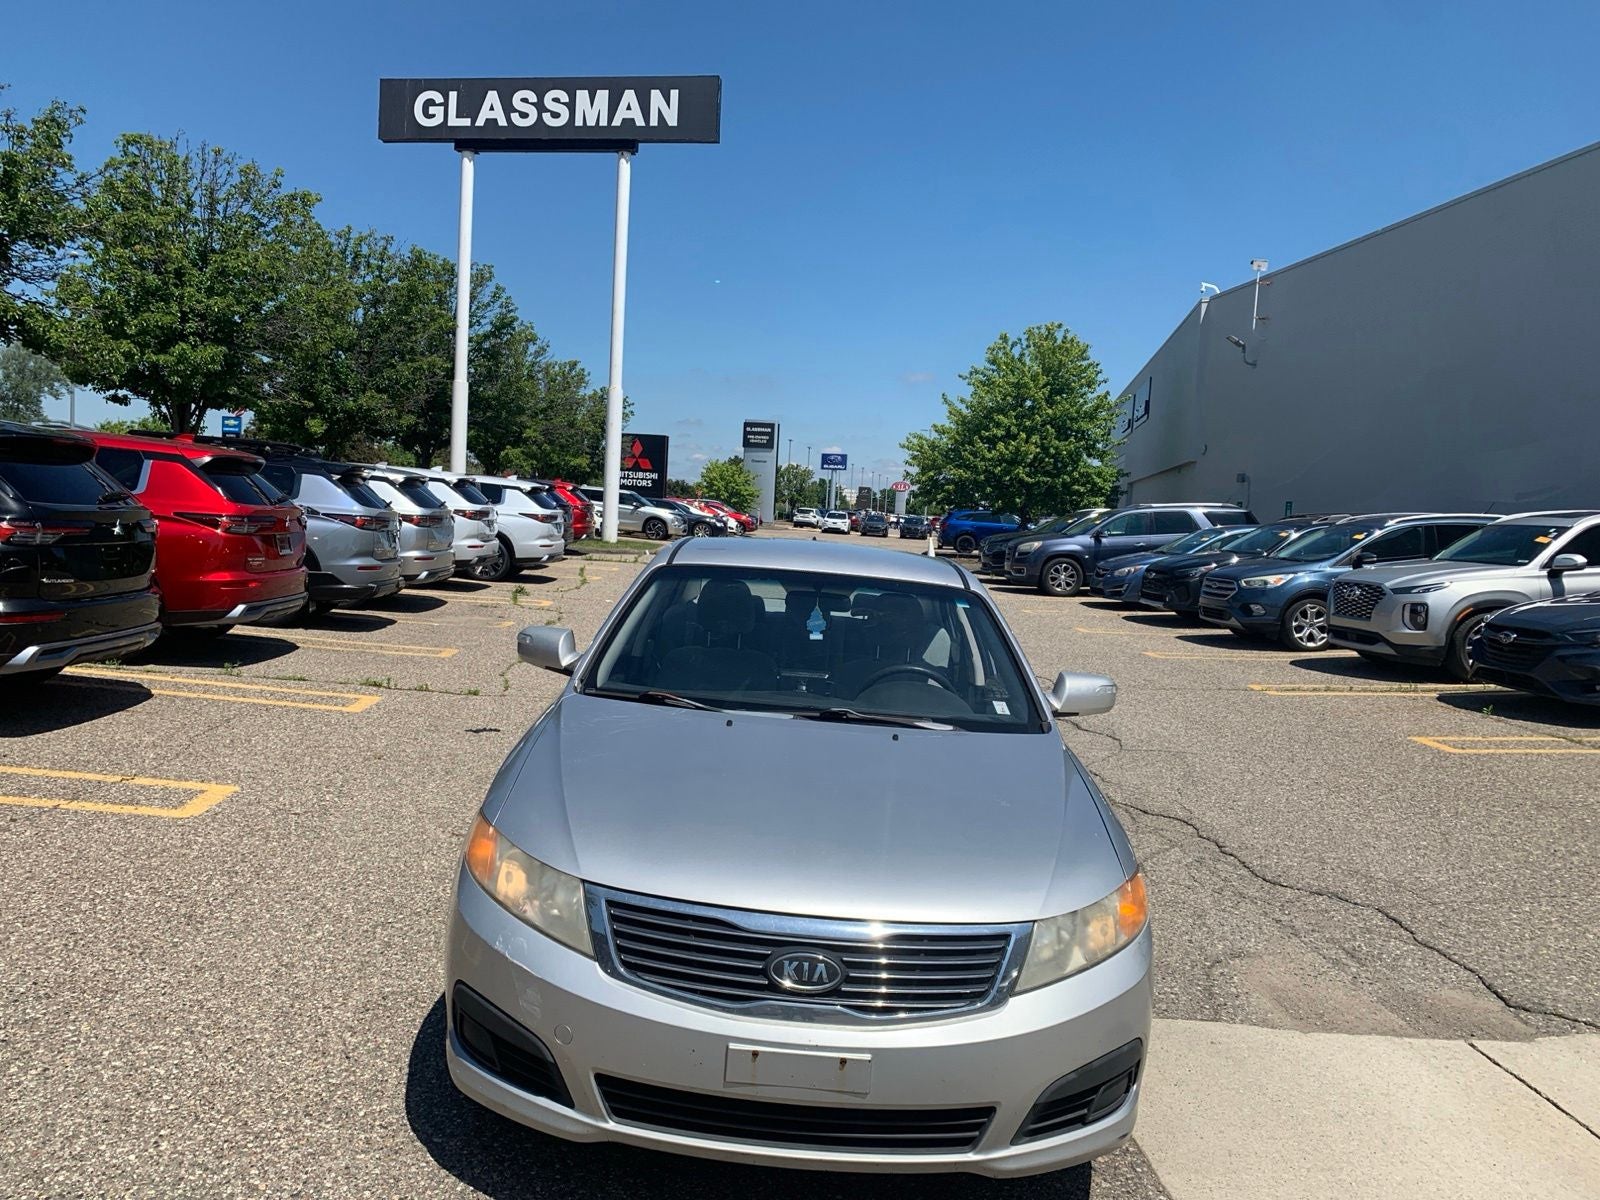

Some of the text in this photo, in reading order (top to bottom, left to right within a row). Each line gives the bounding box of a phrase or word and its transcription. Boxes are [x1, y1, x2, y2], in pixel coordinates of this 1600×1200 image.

[413, 88, 680, 127] GLASSMAN
[620, 478, 652, 487] MOTORS
[782, 960, 829, 983] KIA
